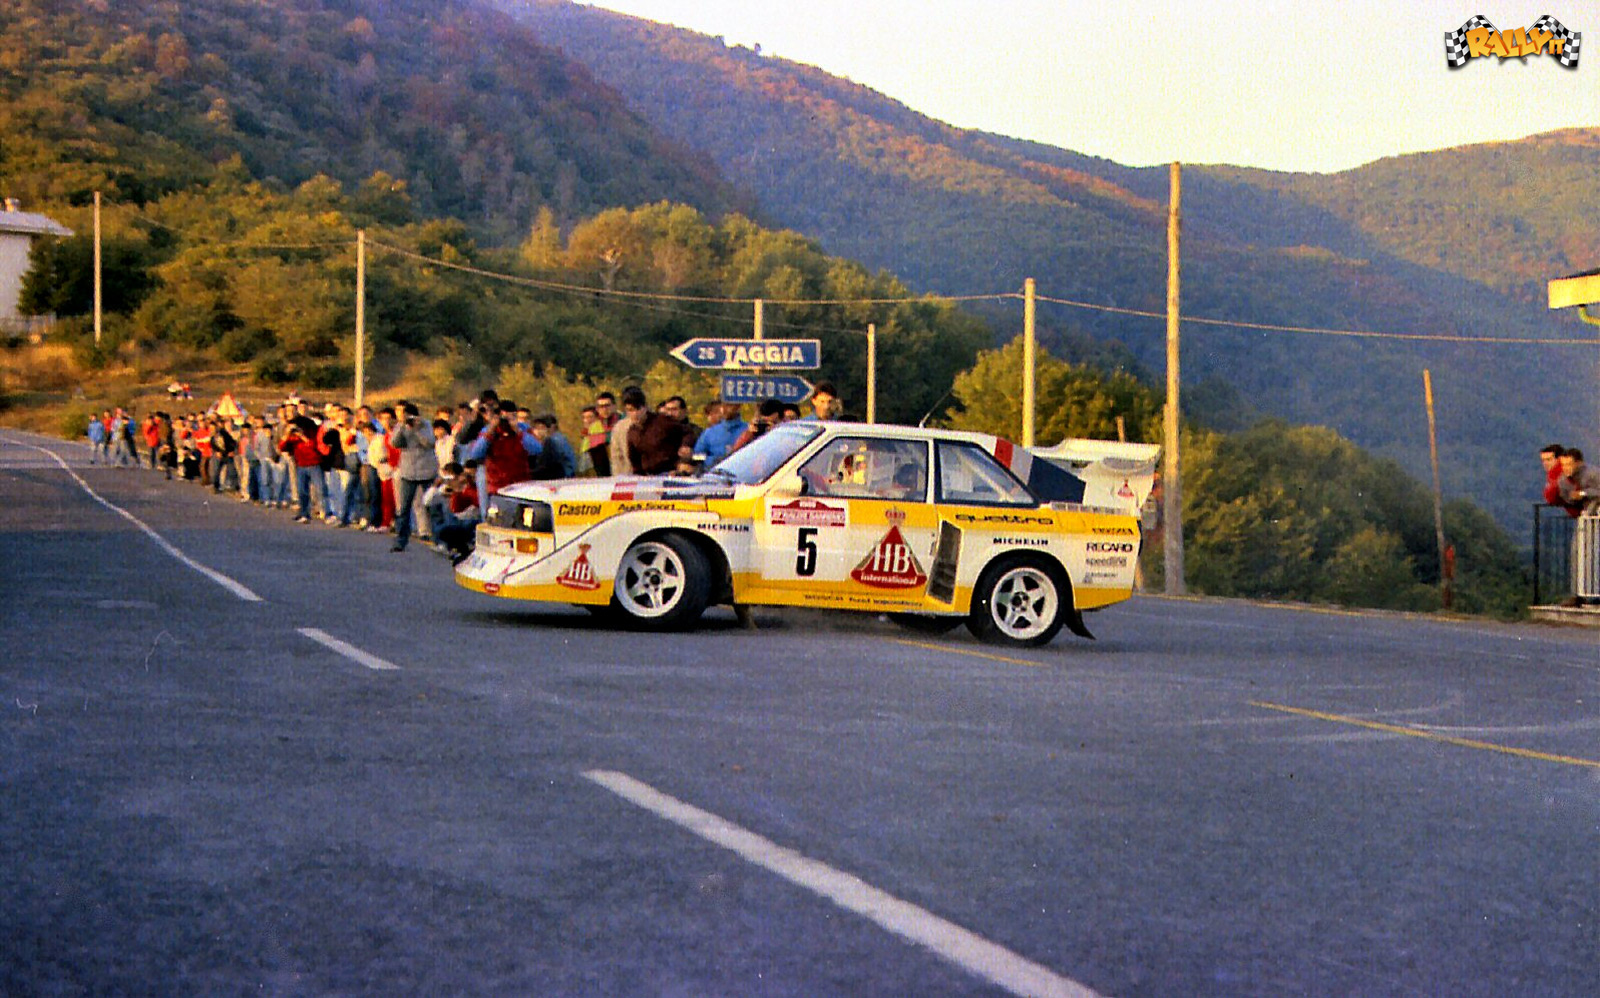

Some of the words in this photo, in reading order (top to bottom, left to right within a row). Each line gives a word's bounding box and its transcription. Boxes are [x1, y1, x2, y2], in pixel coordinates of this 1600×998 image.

[723, 345, 804, 364] TAGGIA
[726, 380, 775, 397] REZZO
[558, 503, 602, 516] Castrol
[955, 513, 1054, 525] quattro
[697, 523, 750, 532] MICHELIN
[993, 537, 1049, 546] MICHELIN
[1086, 542, 1133, 552] RECARO
[796, 527, 818, 576] 5
[873, 543, 910, 574] HB
[568, 562, 591, 580] HB
